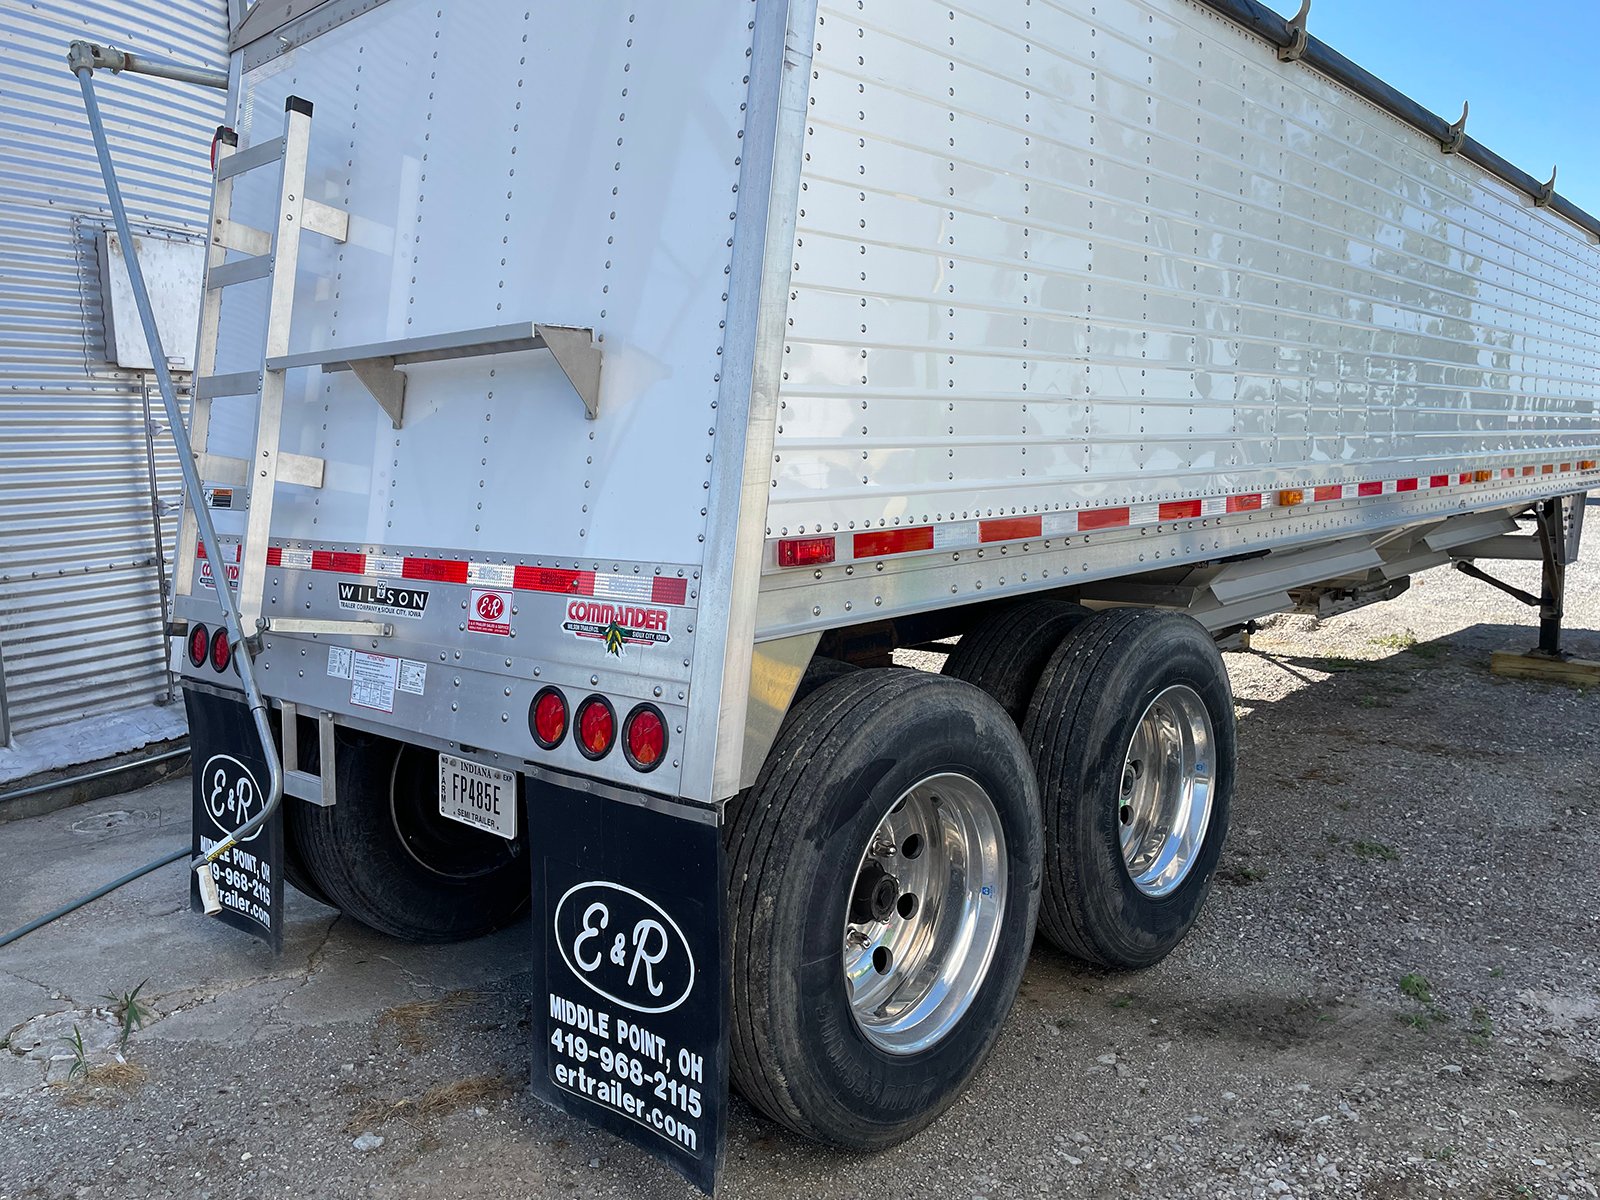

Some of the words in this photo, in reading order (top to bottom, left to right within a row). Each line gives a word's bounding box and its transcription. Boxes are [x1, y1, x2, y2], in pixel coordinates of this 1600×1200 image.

[340, 601, 356, 609] TRAILER
[356, 603, 378, 612] COMPANY
[408, 610, 422, 618] IOWA
[341, 585, 424, 608] WILSON
[568, 601, 668, 631] COMMANDER
[460, 761, 492, 779] INDIANA
[503, 774, 512, 782] EXP
[453, 773, 501, 815] FP485E
[457, 808, 470, 818] SEMI
[471, 813, 495, 827] TRAILER
[233, 848, 260, 879] POINT,
[261, 861, 271, 883] OH
[550, 993, 609, 1039] MIDDLE
[617, 1019, 672, 1074] POINT,
[678, 1048, 704, 1083] OH
[550, 1028, 702, 1118] 419-968-2115
[555, 1062, 697, 1151] ertrailer.com
